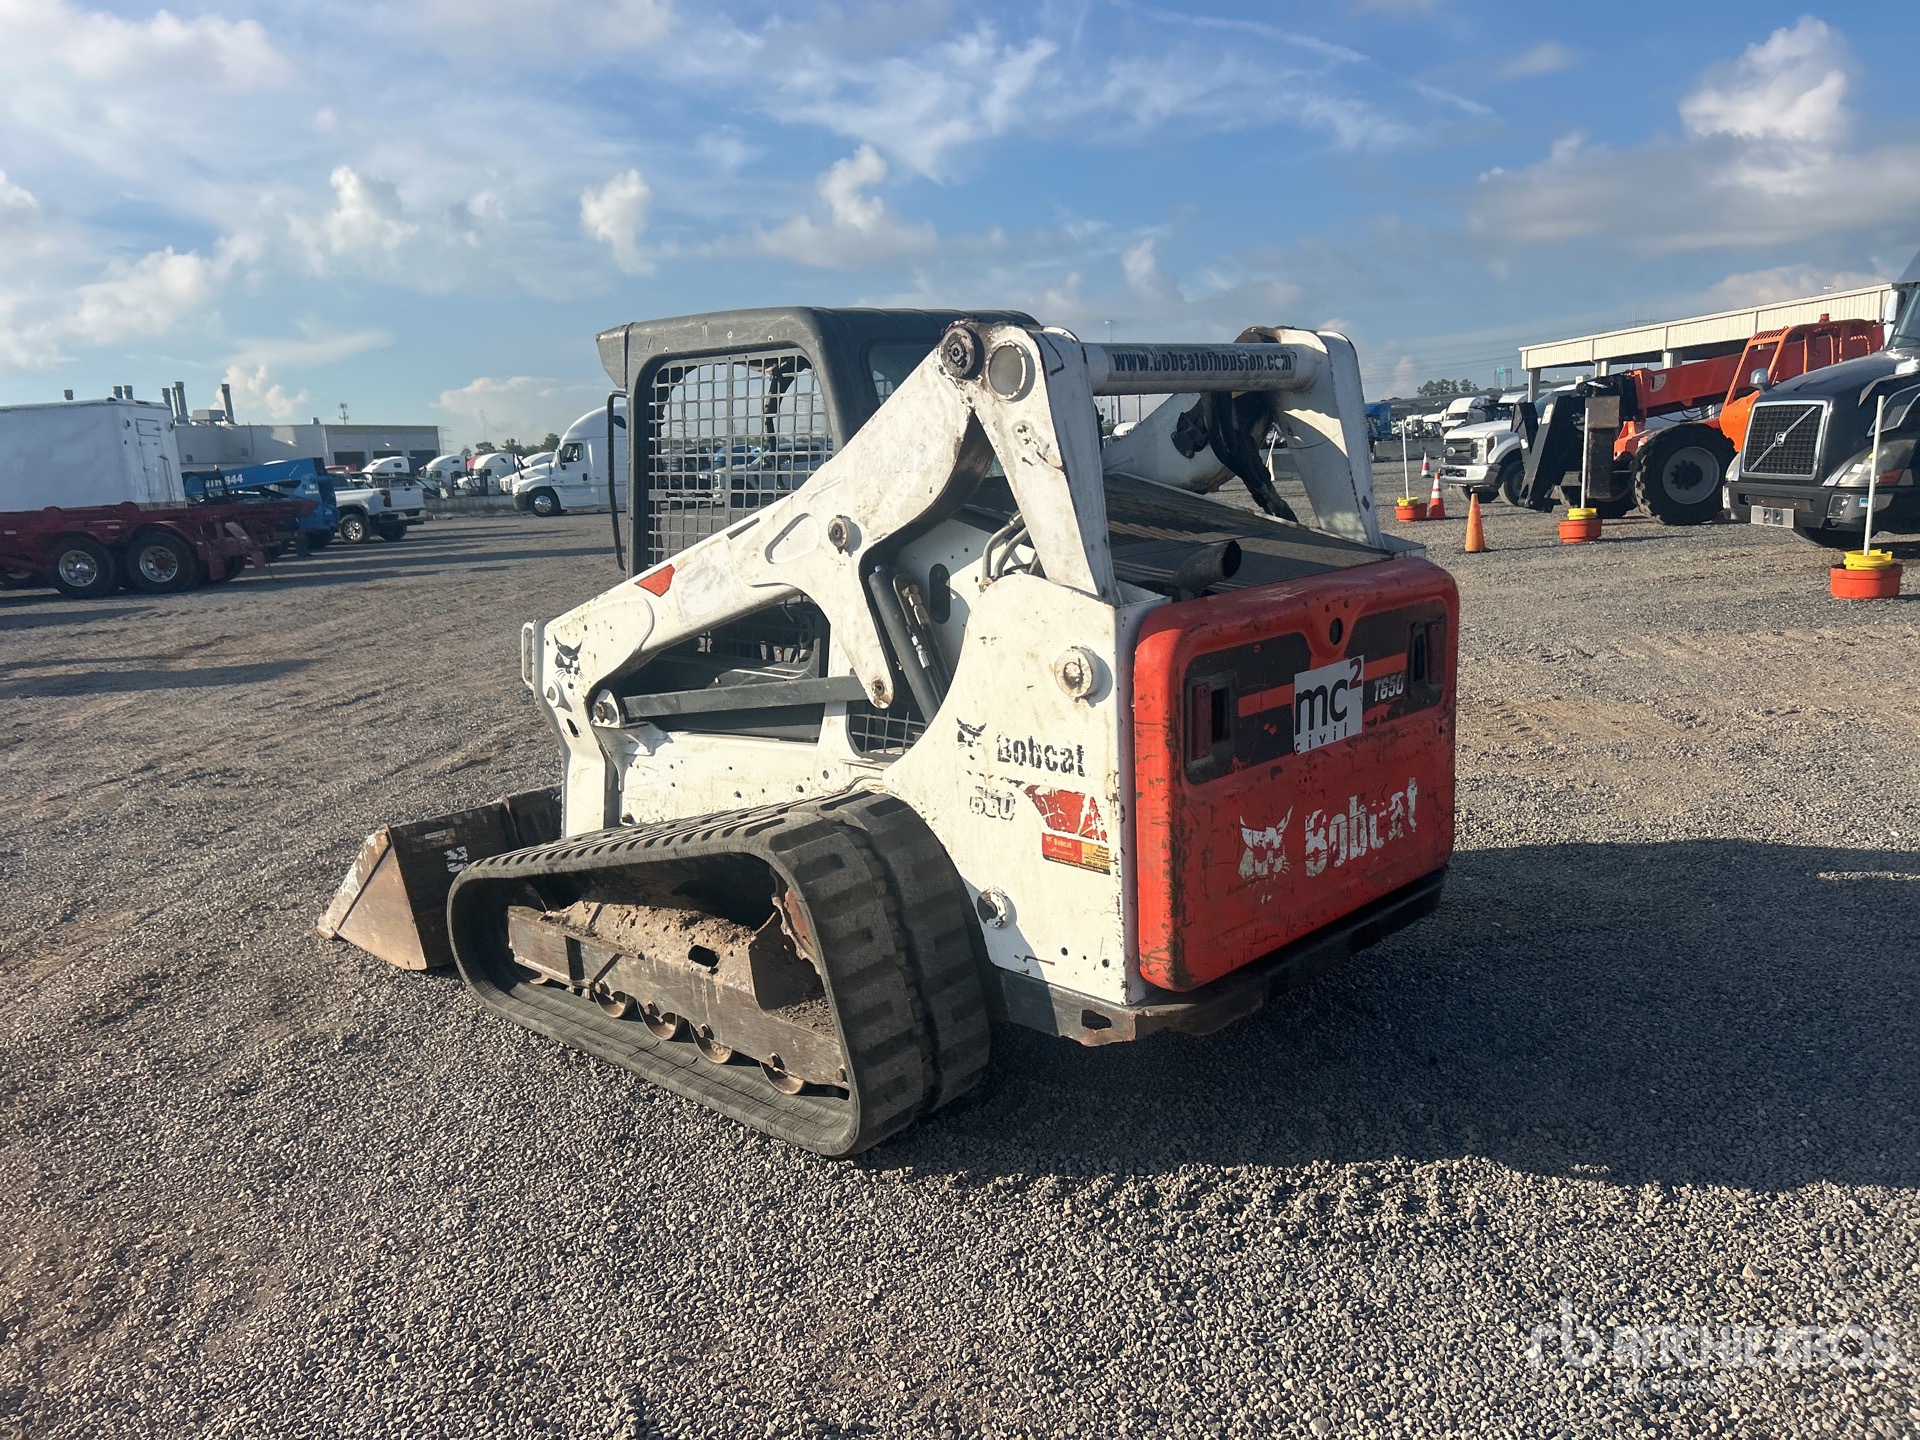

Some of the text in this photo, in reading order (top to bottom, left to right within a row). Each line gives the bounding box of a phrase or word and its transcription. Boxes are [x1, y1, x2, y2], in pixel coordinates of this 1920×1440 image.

[996, 730, 1085, 777] Bobcat
[1295, 722, 1347, 753] civil
[1305, 777, 1418, 877] Bobcat
